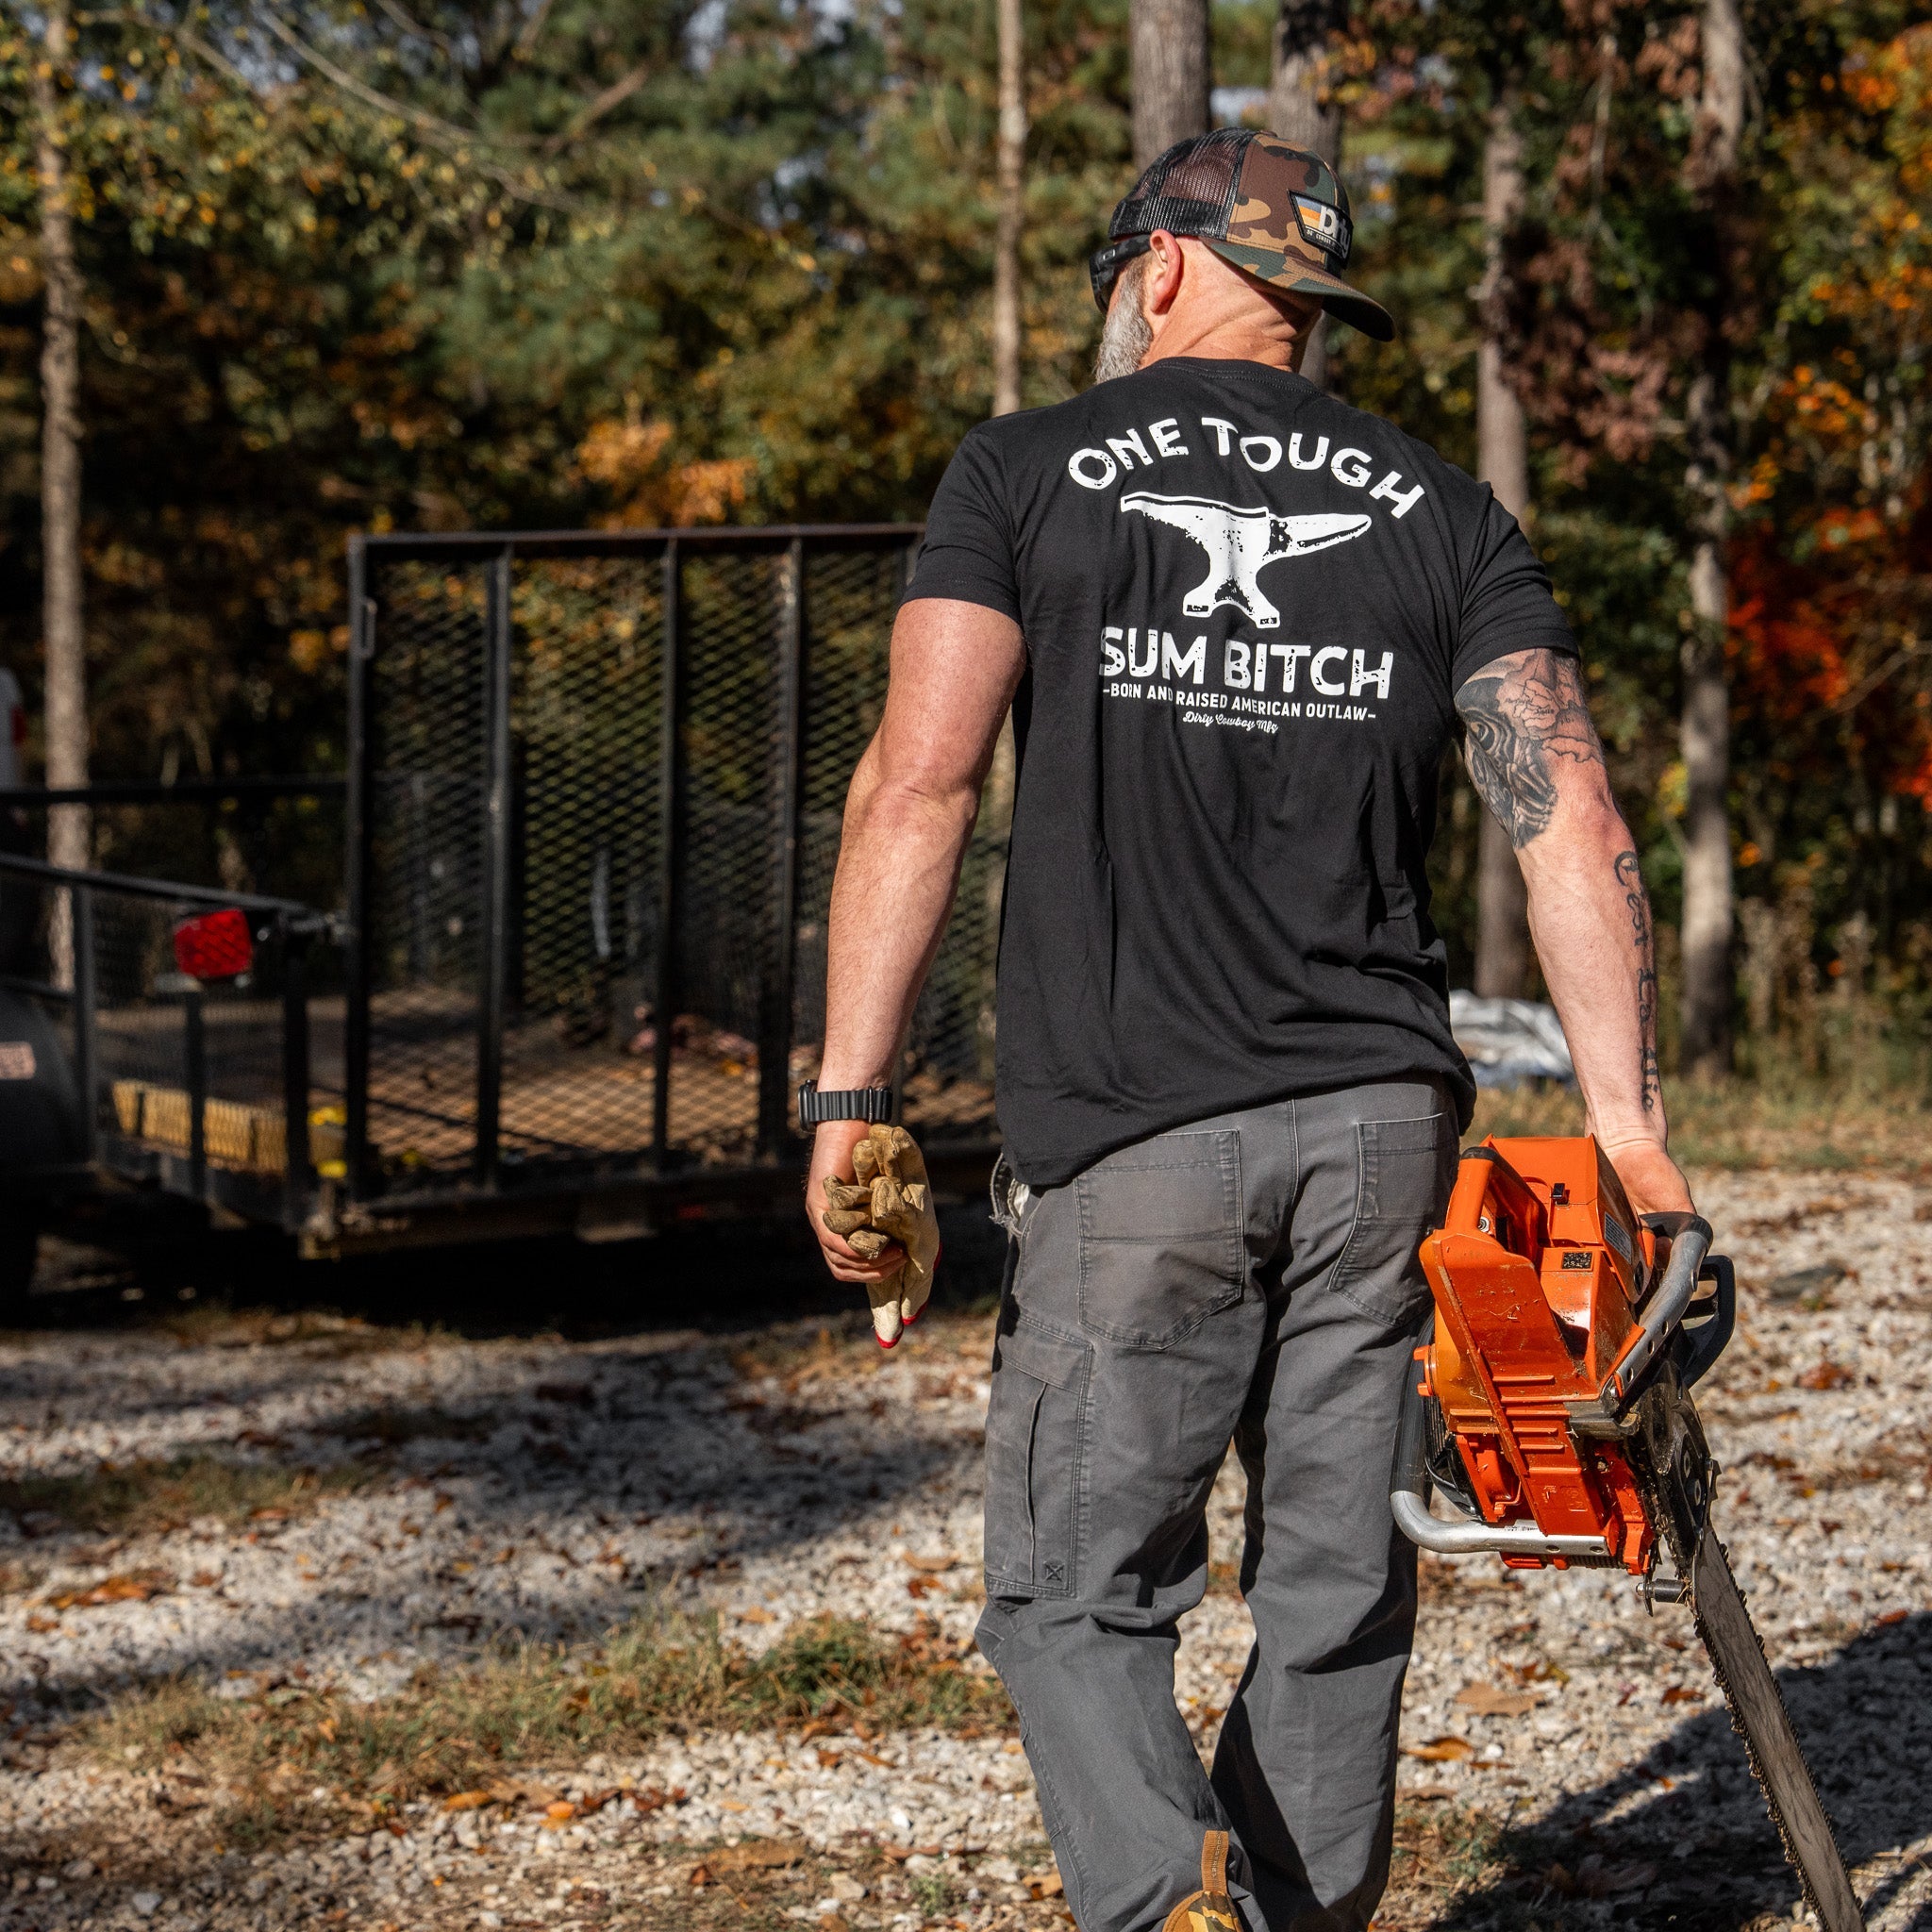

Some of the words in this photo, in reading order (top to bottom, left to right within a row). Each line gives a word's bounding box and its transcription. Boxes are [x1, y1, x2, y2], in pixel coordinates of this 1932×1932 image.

[1068, 417, 1190, 490] ONE
[1201, 416, 1425, 519] TOUGH
[1099, 625, 1208, 685] SUM
[1224, 640, 1394, 700] BITCH
[1146, 684, 1174, 702] AND
[1175, 691, 1228, 708] RAISED
[1230, 696, 1302, 718] AMERICAN
[1182, 710, 1215, 727] Dirty
[1215, 713, 1257, 732] Cowboy
[1256, 719, 1279, 734] Mfg
[1211, 1831, 1223, 1877] NDUSTRIES
